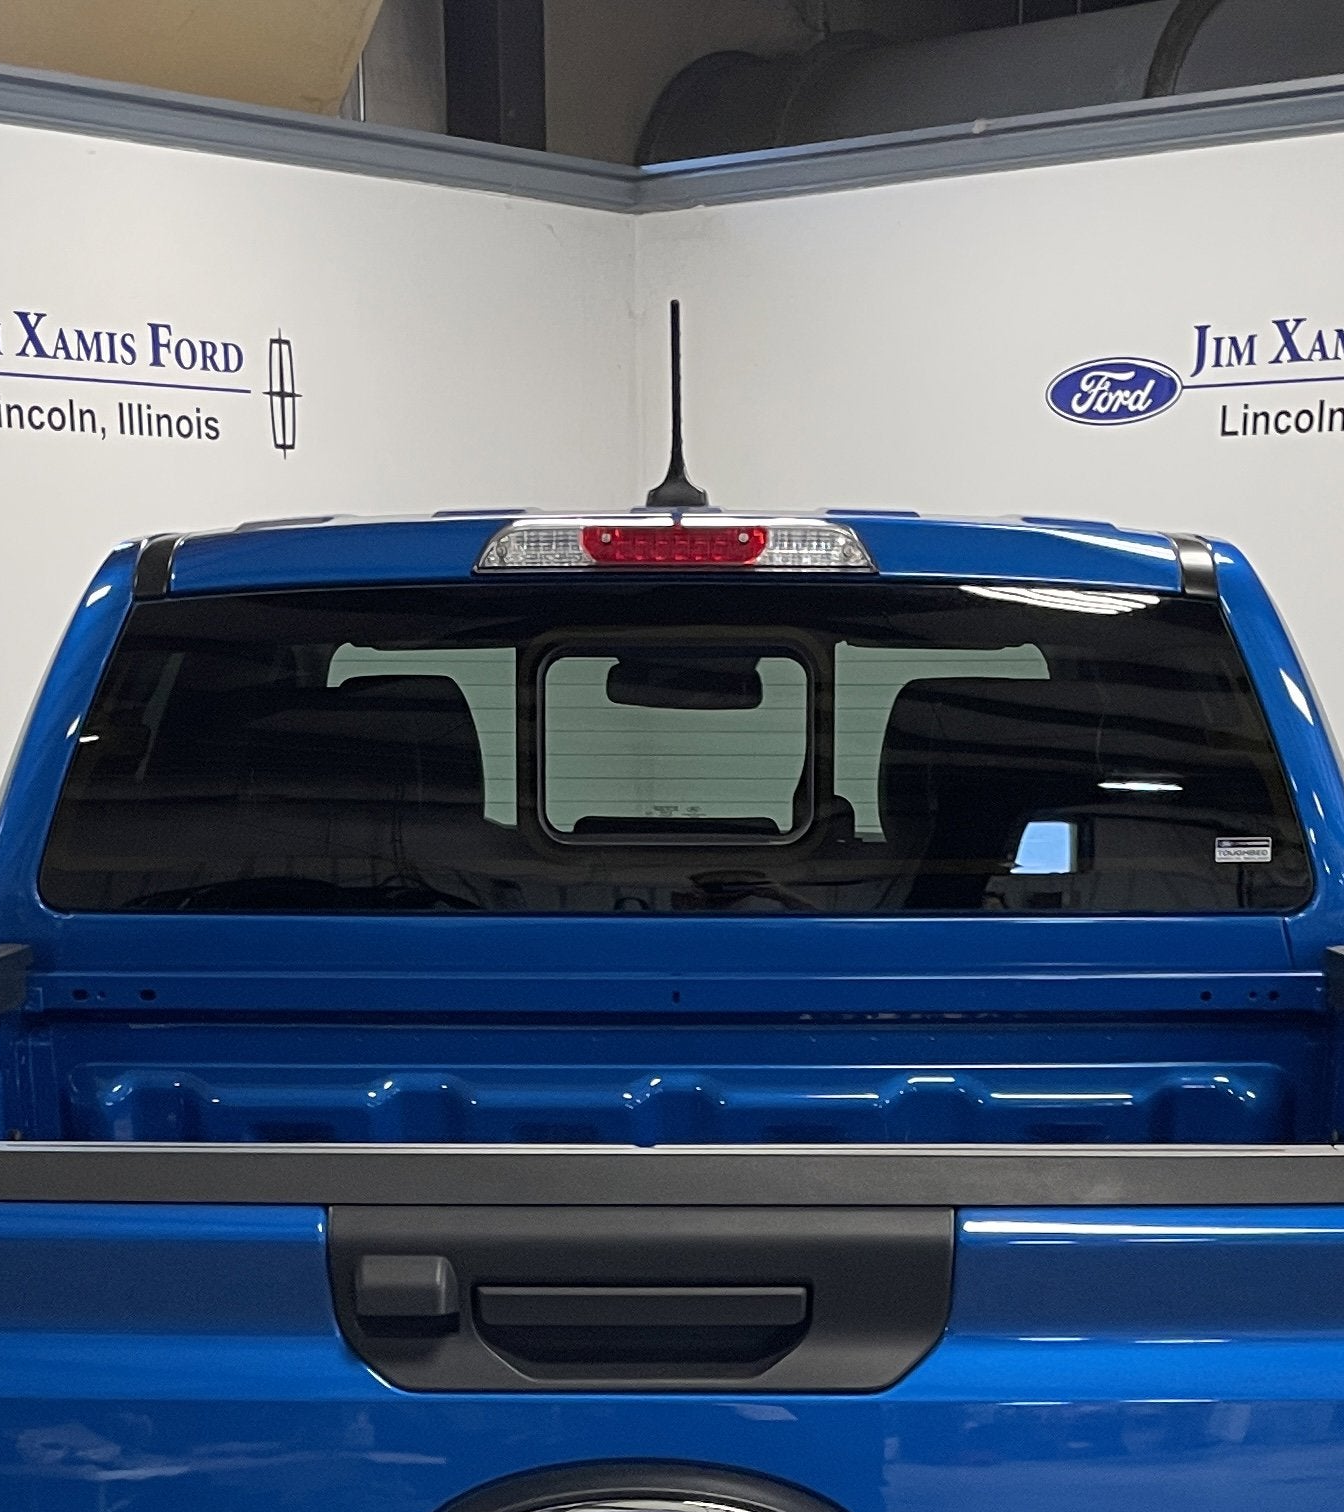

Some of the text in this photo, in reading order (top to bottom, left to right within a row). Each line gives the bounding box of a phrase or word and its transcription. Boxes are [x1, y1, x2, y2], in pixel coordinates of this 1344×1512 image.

[13, 310, 137, 366] XAMIS
[146, 322, 244, 373] FORD
[1189, 324, 1258, 377] JIM
[1070, 370, 1154, 415] Ford
[118, 402, 220, 440] Illinois
